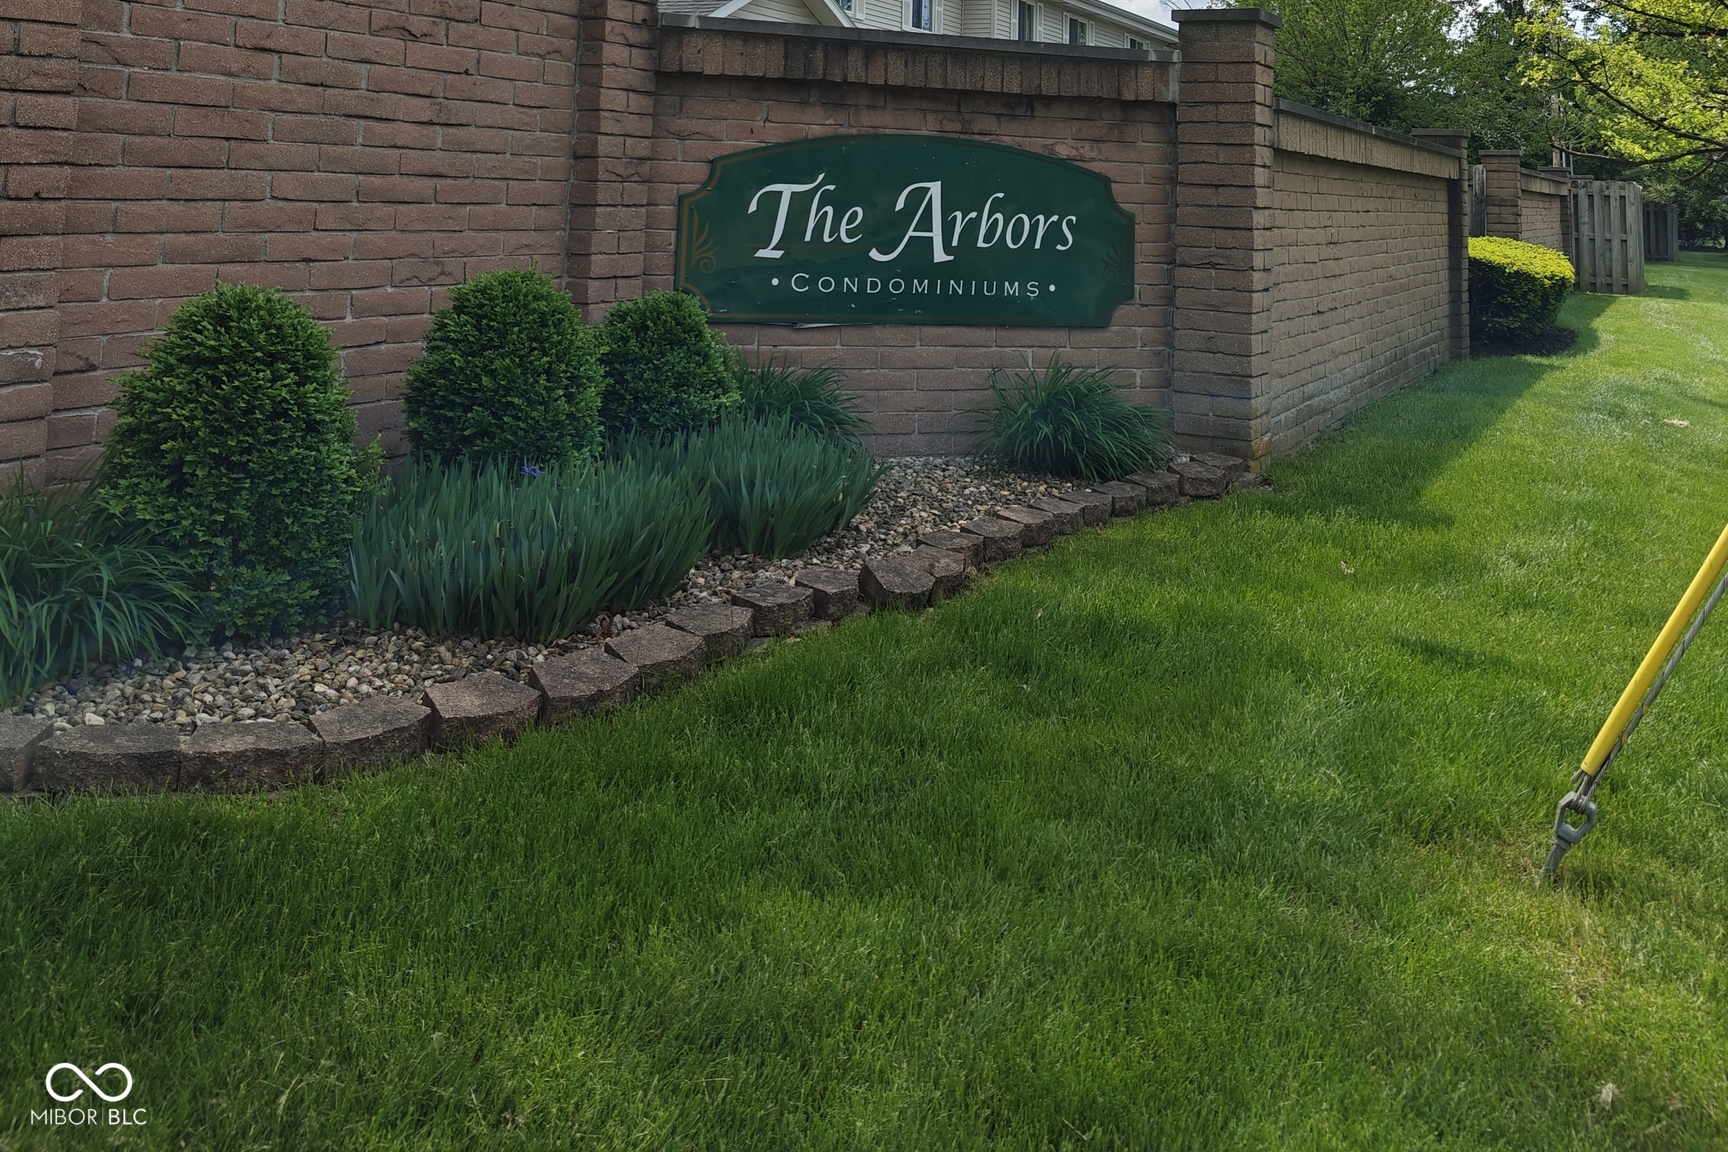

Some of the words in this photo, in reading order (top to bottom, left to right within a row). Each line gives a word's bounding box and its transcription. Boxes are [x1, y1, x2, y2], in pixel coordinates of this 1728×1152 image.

[747, 172, 865, 259] The
[868, 180, 1077, 264] Arbors
[790, 272, 1041, 298] CONDOMINIUMS
